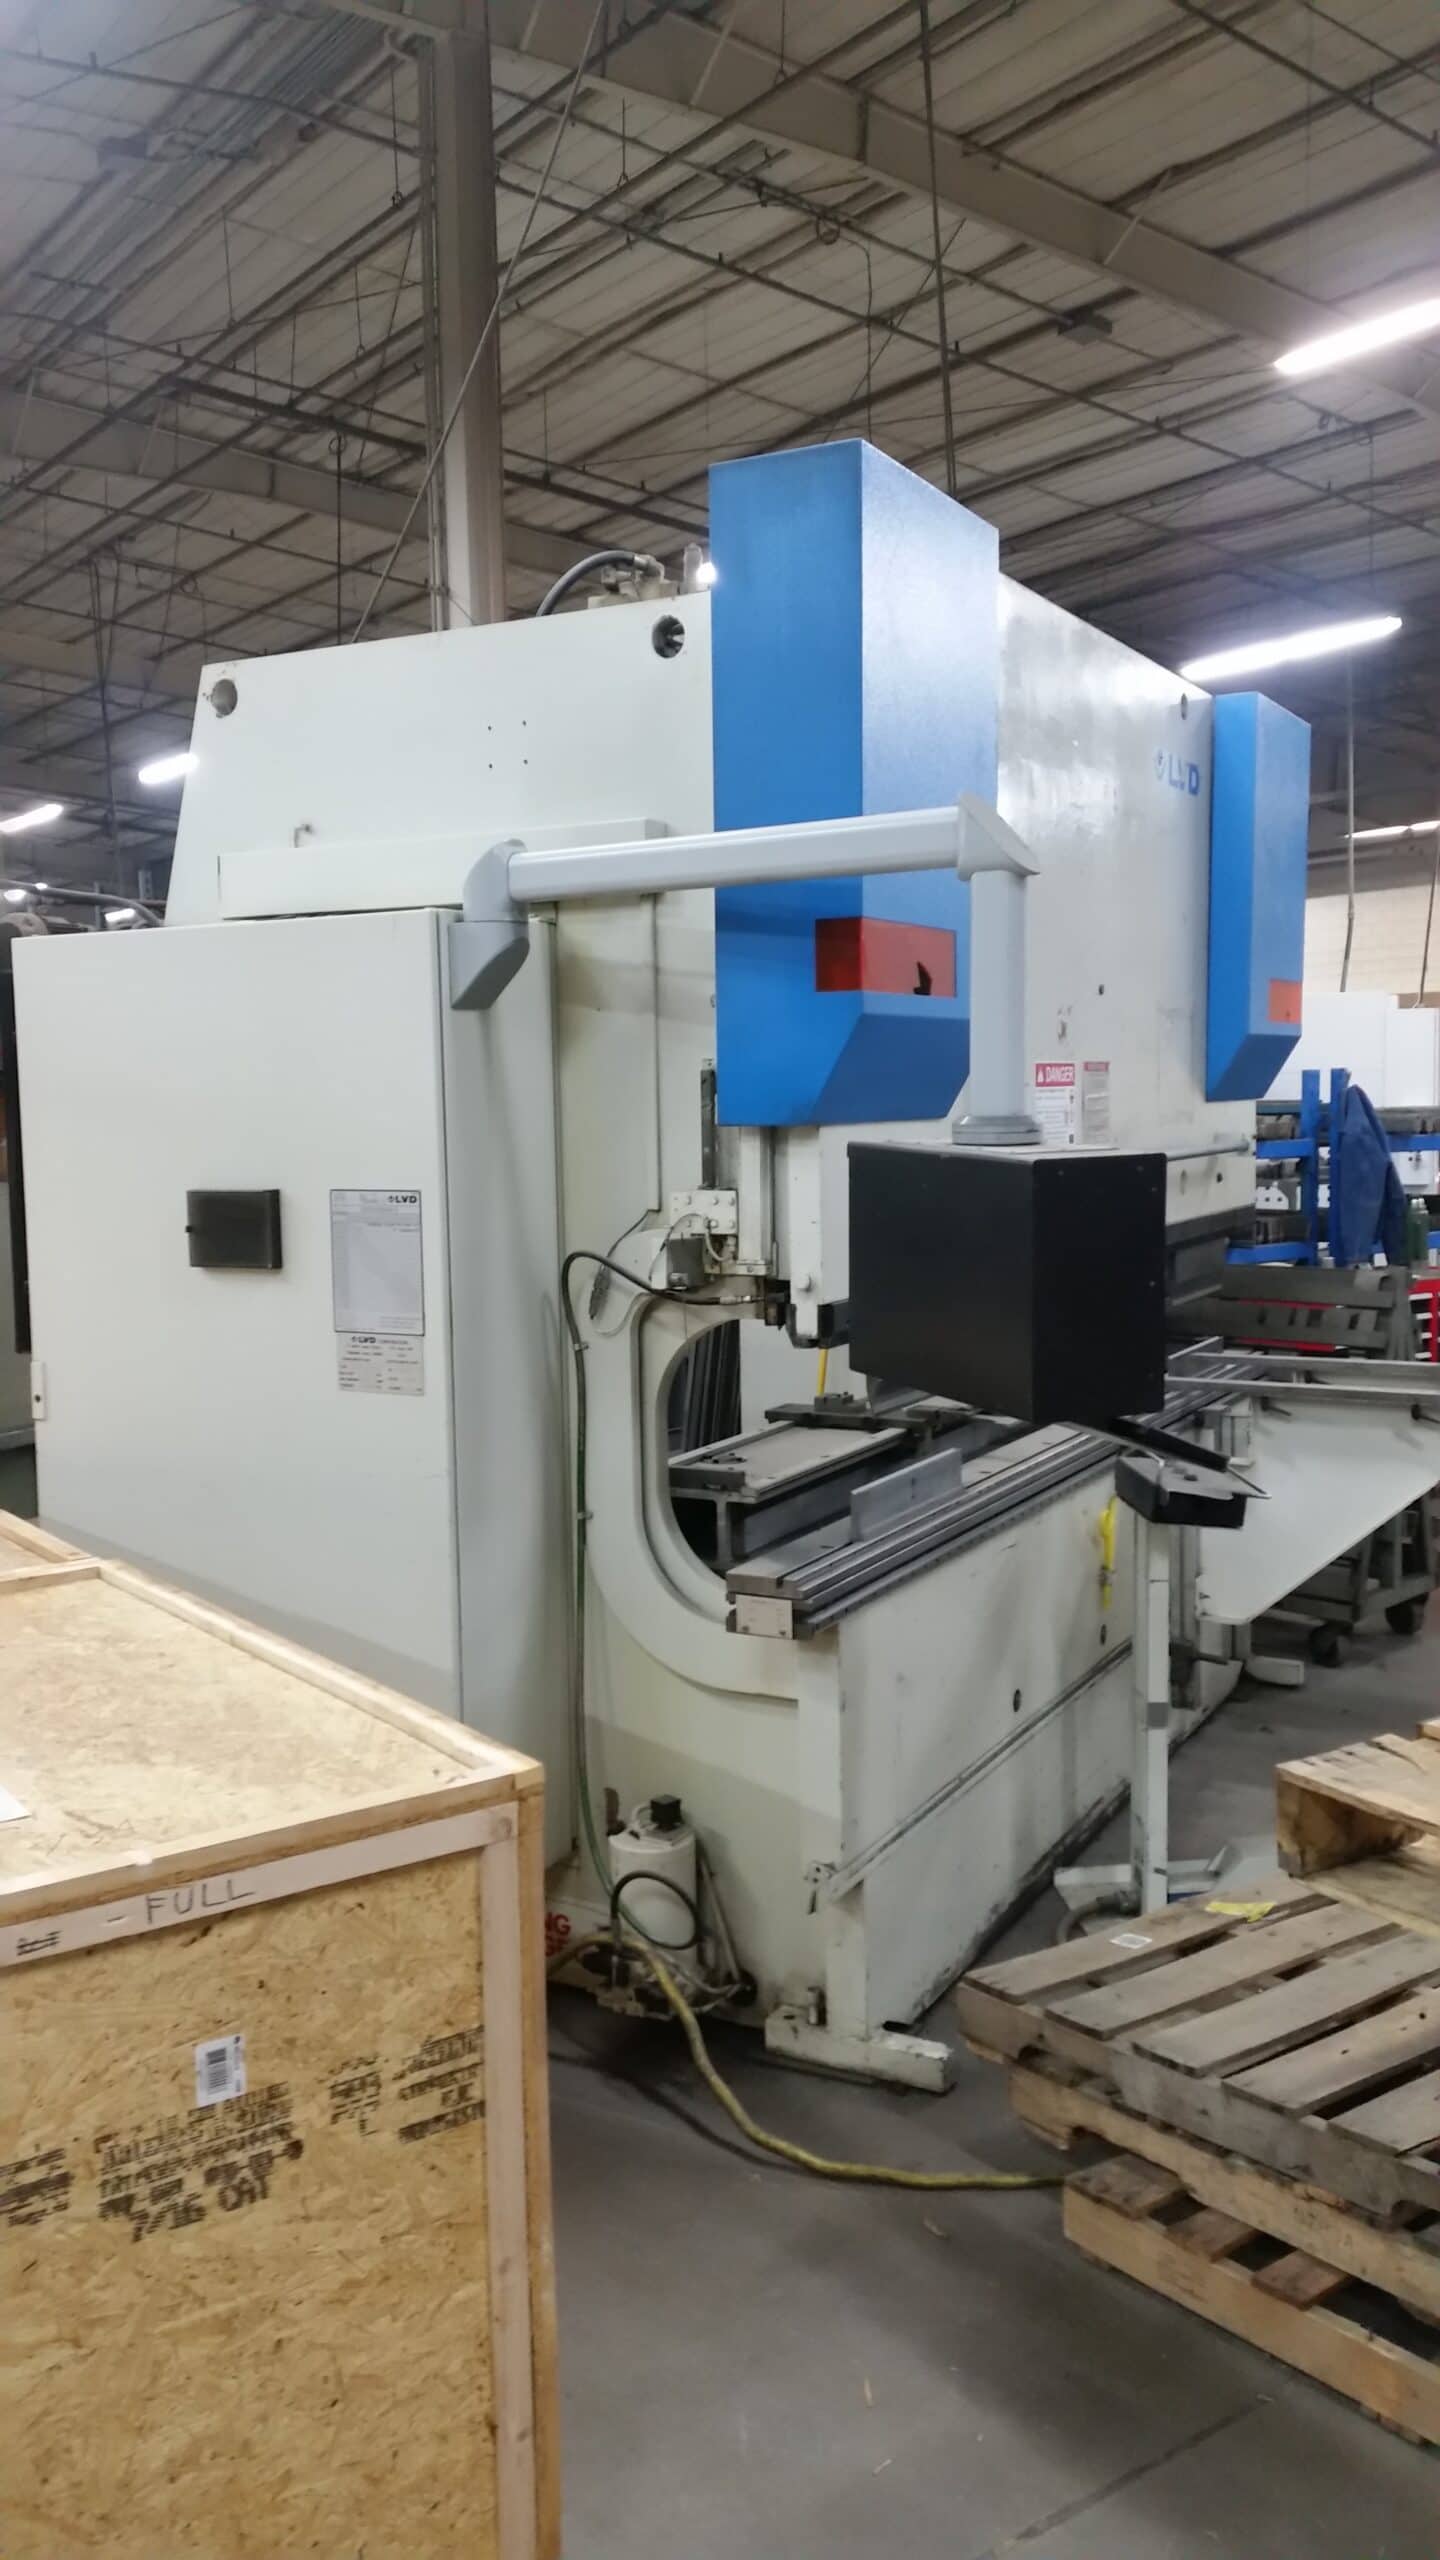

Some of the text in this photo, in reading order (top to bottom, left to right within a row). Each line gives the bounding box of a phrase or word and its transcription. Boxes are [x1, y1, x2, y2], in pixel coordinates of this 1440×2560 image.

[1045, 1064, 1074, 1083] DANGER
[395, 1194, 417, 1204] LVD
[145, 1878, 256, 1925] FULL
